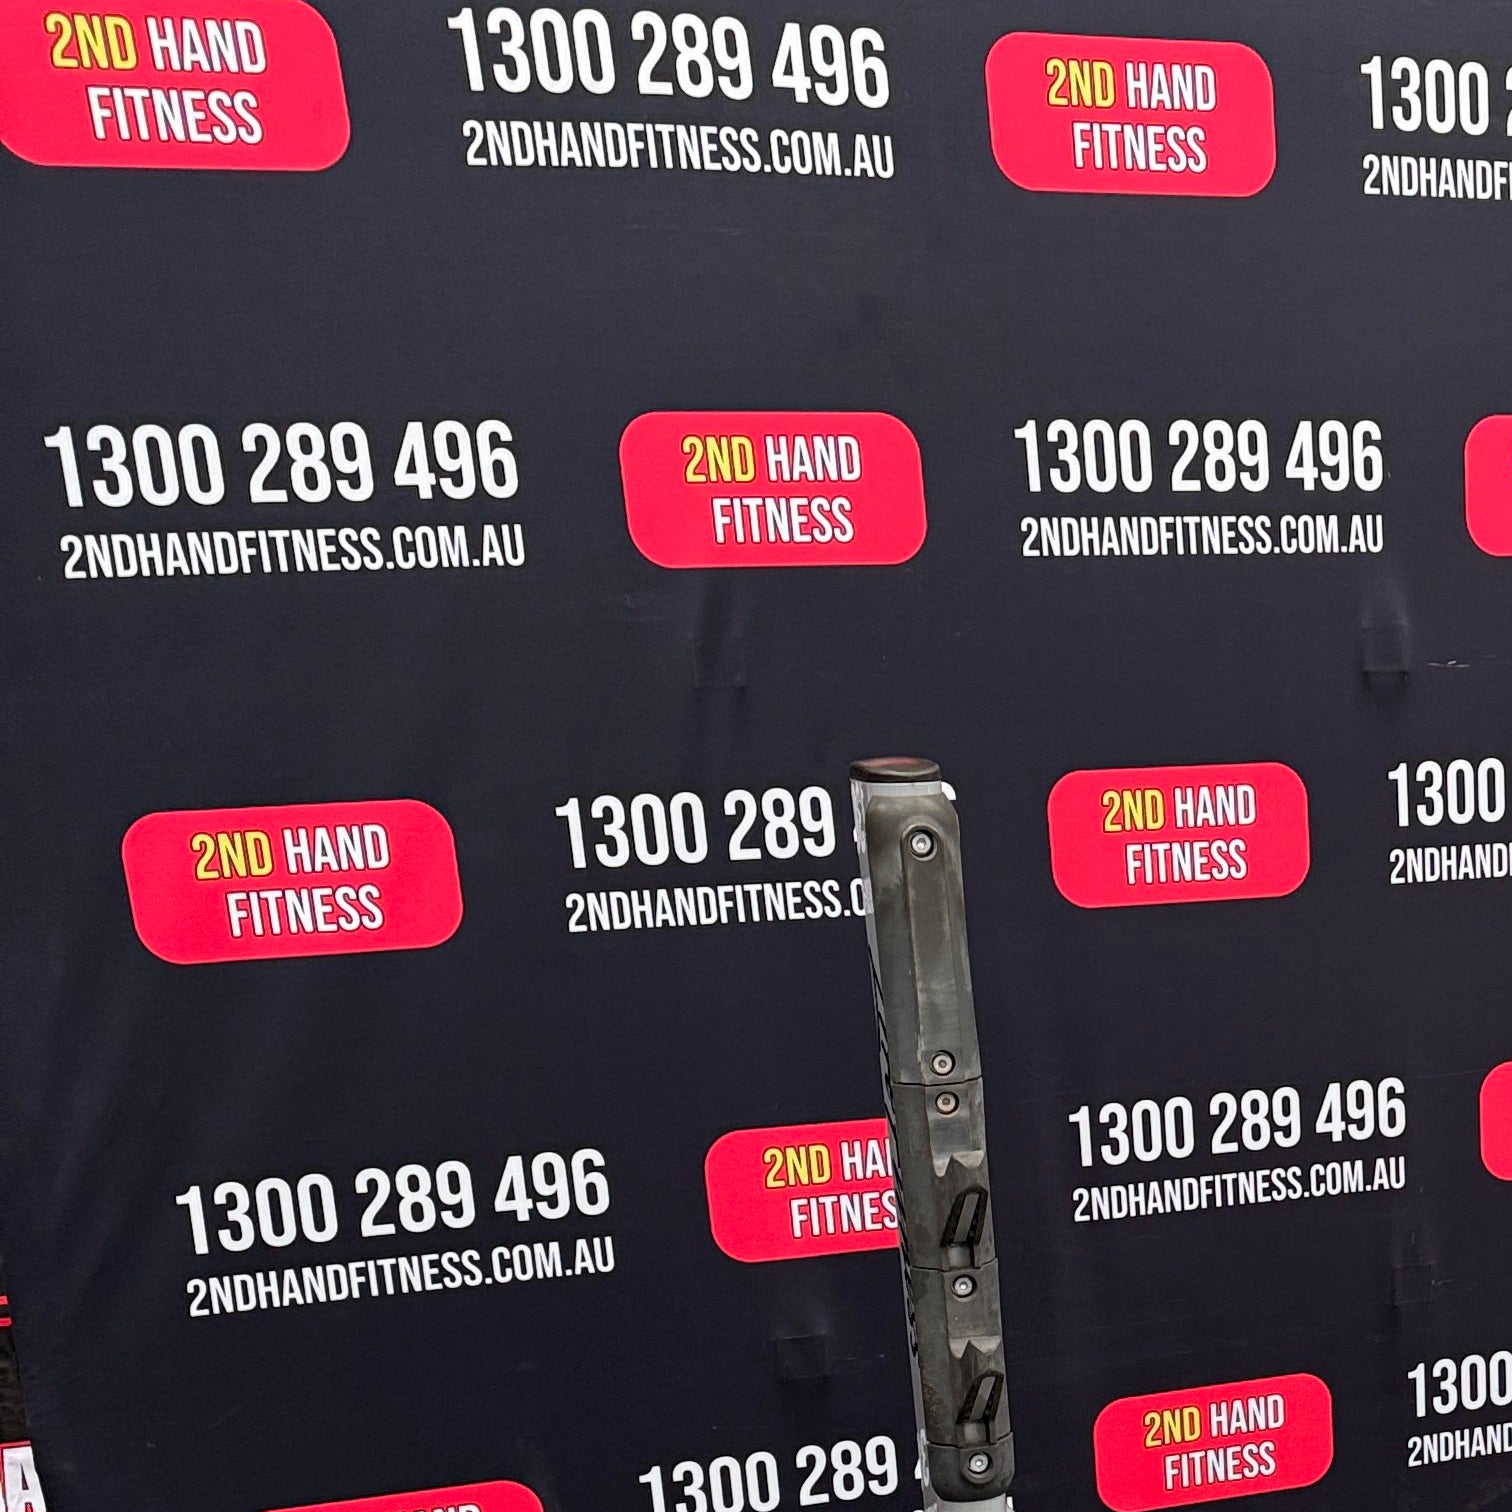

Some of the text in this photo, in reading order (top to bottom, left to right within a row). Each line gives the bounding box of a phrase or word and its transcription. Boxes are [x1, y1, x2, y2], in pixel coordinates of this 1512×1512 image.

[45, 13, 267, 74] 2ND HAND
[447, 6, 890, 109] 1300 289 496
[1046, 58, 1216, 111] 2ND HAND
[1360, 55, 1490, 136] 1300
[87, 86, 263, 144] FITNESS
[462, 119, 895, 179] 2NDHANDFITNESS.COM.AU
[1072, 119, 1208, 174] FITNESS
[43, 419, 519, 508] 1300 289 496
[682, 435, 861, 483] 2ND HAND
[1013, 418, 1384, 494] 1300 289 496
[712, 496, 854, 544] FITNESS
[1020, 516, 1385, 558] 2NDHANDFITNESS.COM.AU
[59, 523, 525, 580] 2NDHANDFITNESS.COM.AU
[1102, 785, 1257, 832] 2ND HAND
[1387, 757, 1506, 827] 1300
[191, 824, 390, 880] 2ND HAND
[555, 785, 836, 869] 1300 289
[1126, 837, 1247, 885] FITNESS
[226, 884, 383, 937] FITNESS
[565, 876, 867, 933] 2NDHANDFITNESS.C
[1068, 1076, 1406, 1167] 1300 289 496
[763, 1138, 894, 1188] 2ND HA
[1072, 1156, 1408, 1222] 2NDHANDFITNESS.COM.AU
[175, 1148, 610, 1255] 1300 289 496
[790, 1190, 898, 1238] FITNES
[186, 1235, 615, 1318] 2NDHANDFITNESS.COM.AU
[1144, 1394, 1286, 1447] 2ND HAND
[795, 1435, 899, 1506] 289
[1164, 1441, 1276, 1489] FITNESS
